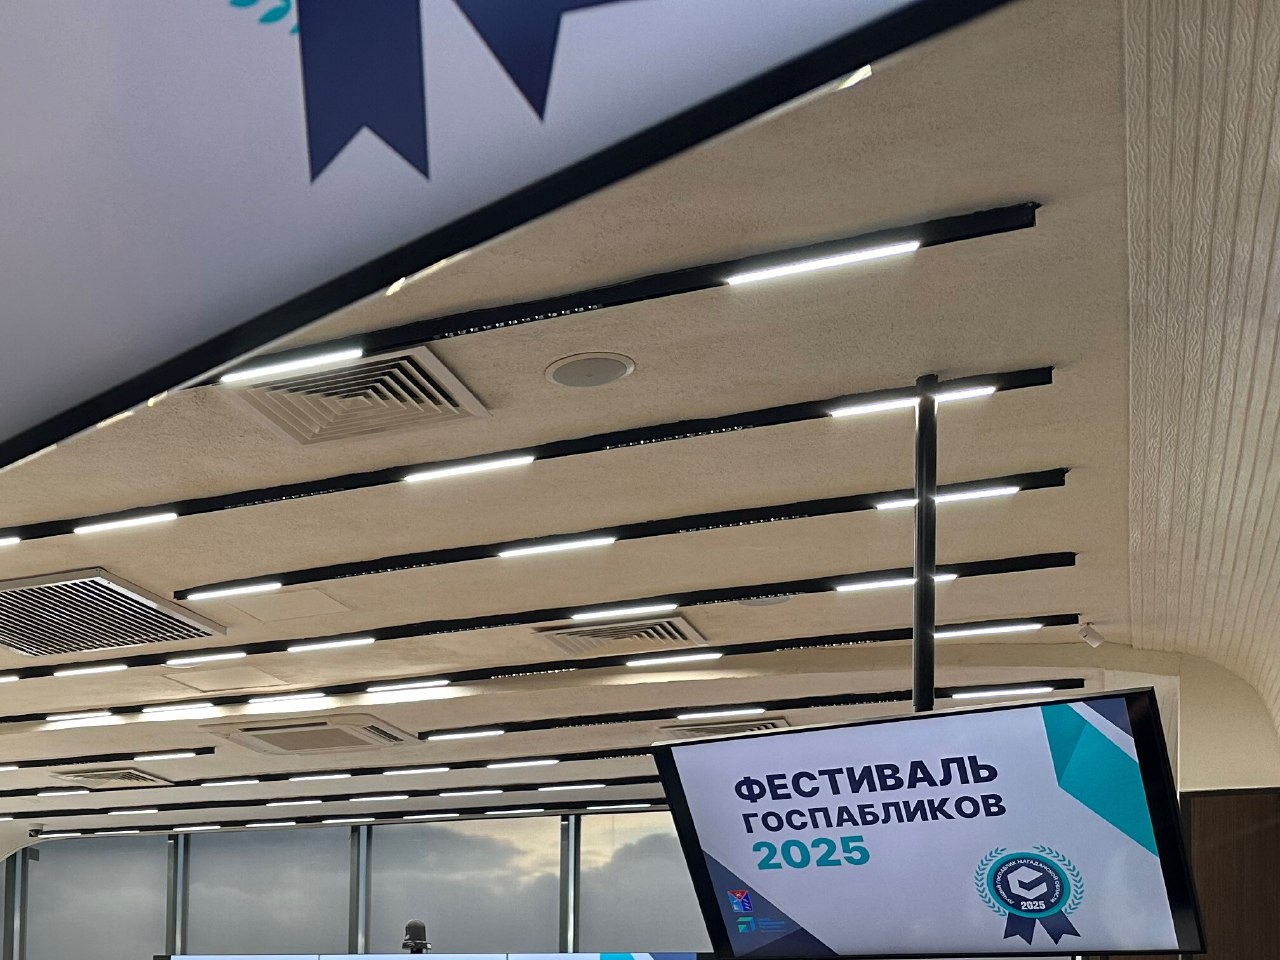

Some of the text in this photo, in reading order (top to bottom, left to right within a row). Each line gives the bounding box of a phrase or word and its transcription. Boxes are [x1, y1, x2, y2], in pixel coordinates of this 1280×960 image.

[734, 755, 999, 803] ФЕСТИВАЛЬ
[742, 793, 1007, 834] ГОСПАБЛИКОВ
[752, 835, 871, 870] 2025
[1020, 900, 1046, 910] 2025
